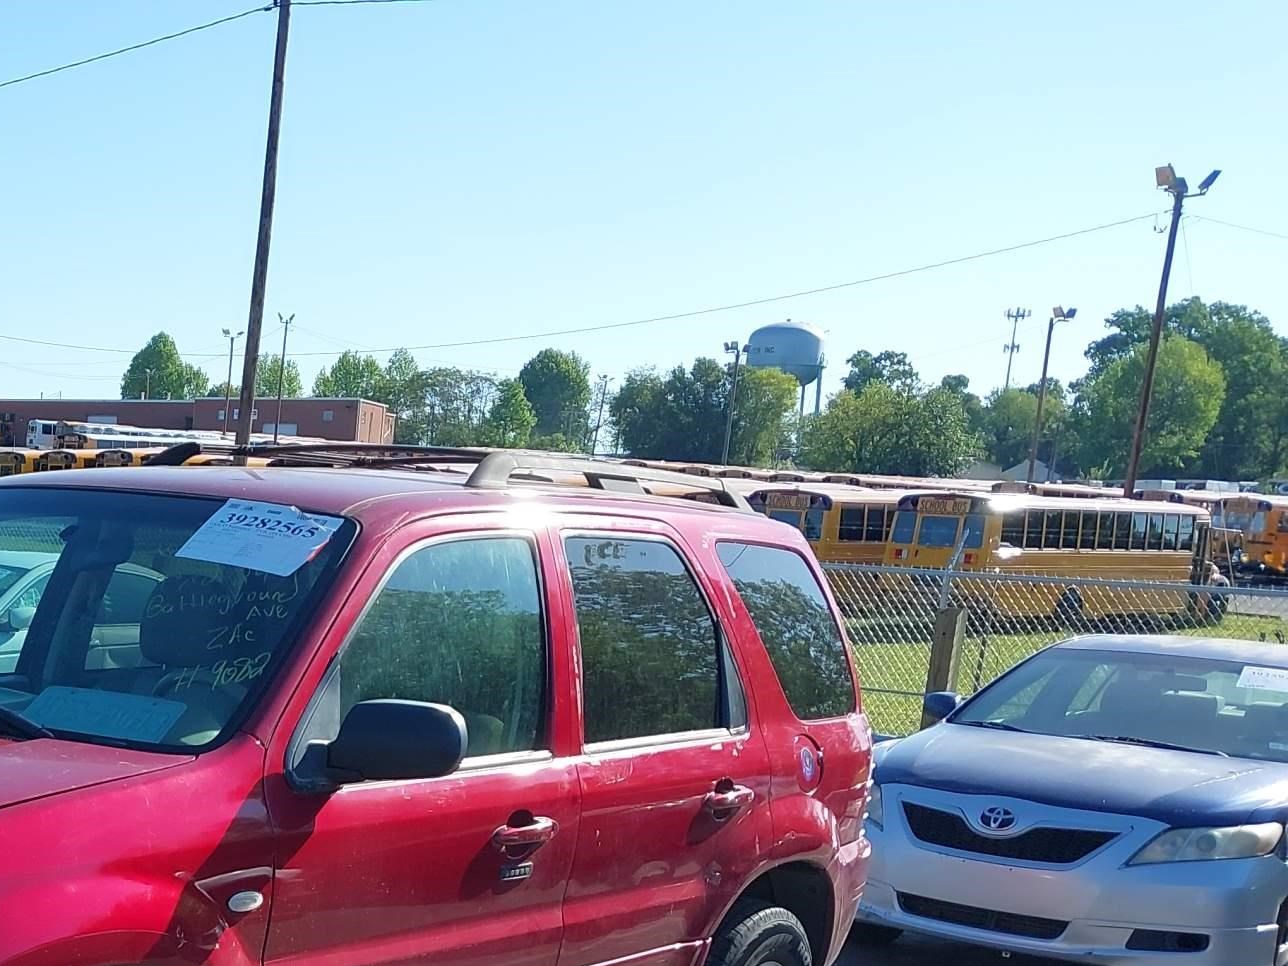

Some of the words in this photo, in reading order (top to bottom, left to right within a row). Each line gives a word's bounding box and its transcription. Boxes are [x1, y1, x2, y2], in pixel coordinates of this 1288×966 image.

[767, 494, 793, 508] SCHOOL
[794, 496, 808, 509] BUS
[920, 500, 948, 513] SCHOOL
[950, 501, 968, 514] BUS
[220, 512, 320, 538] 39282565
